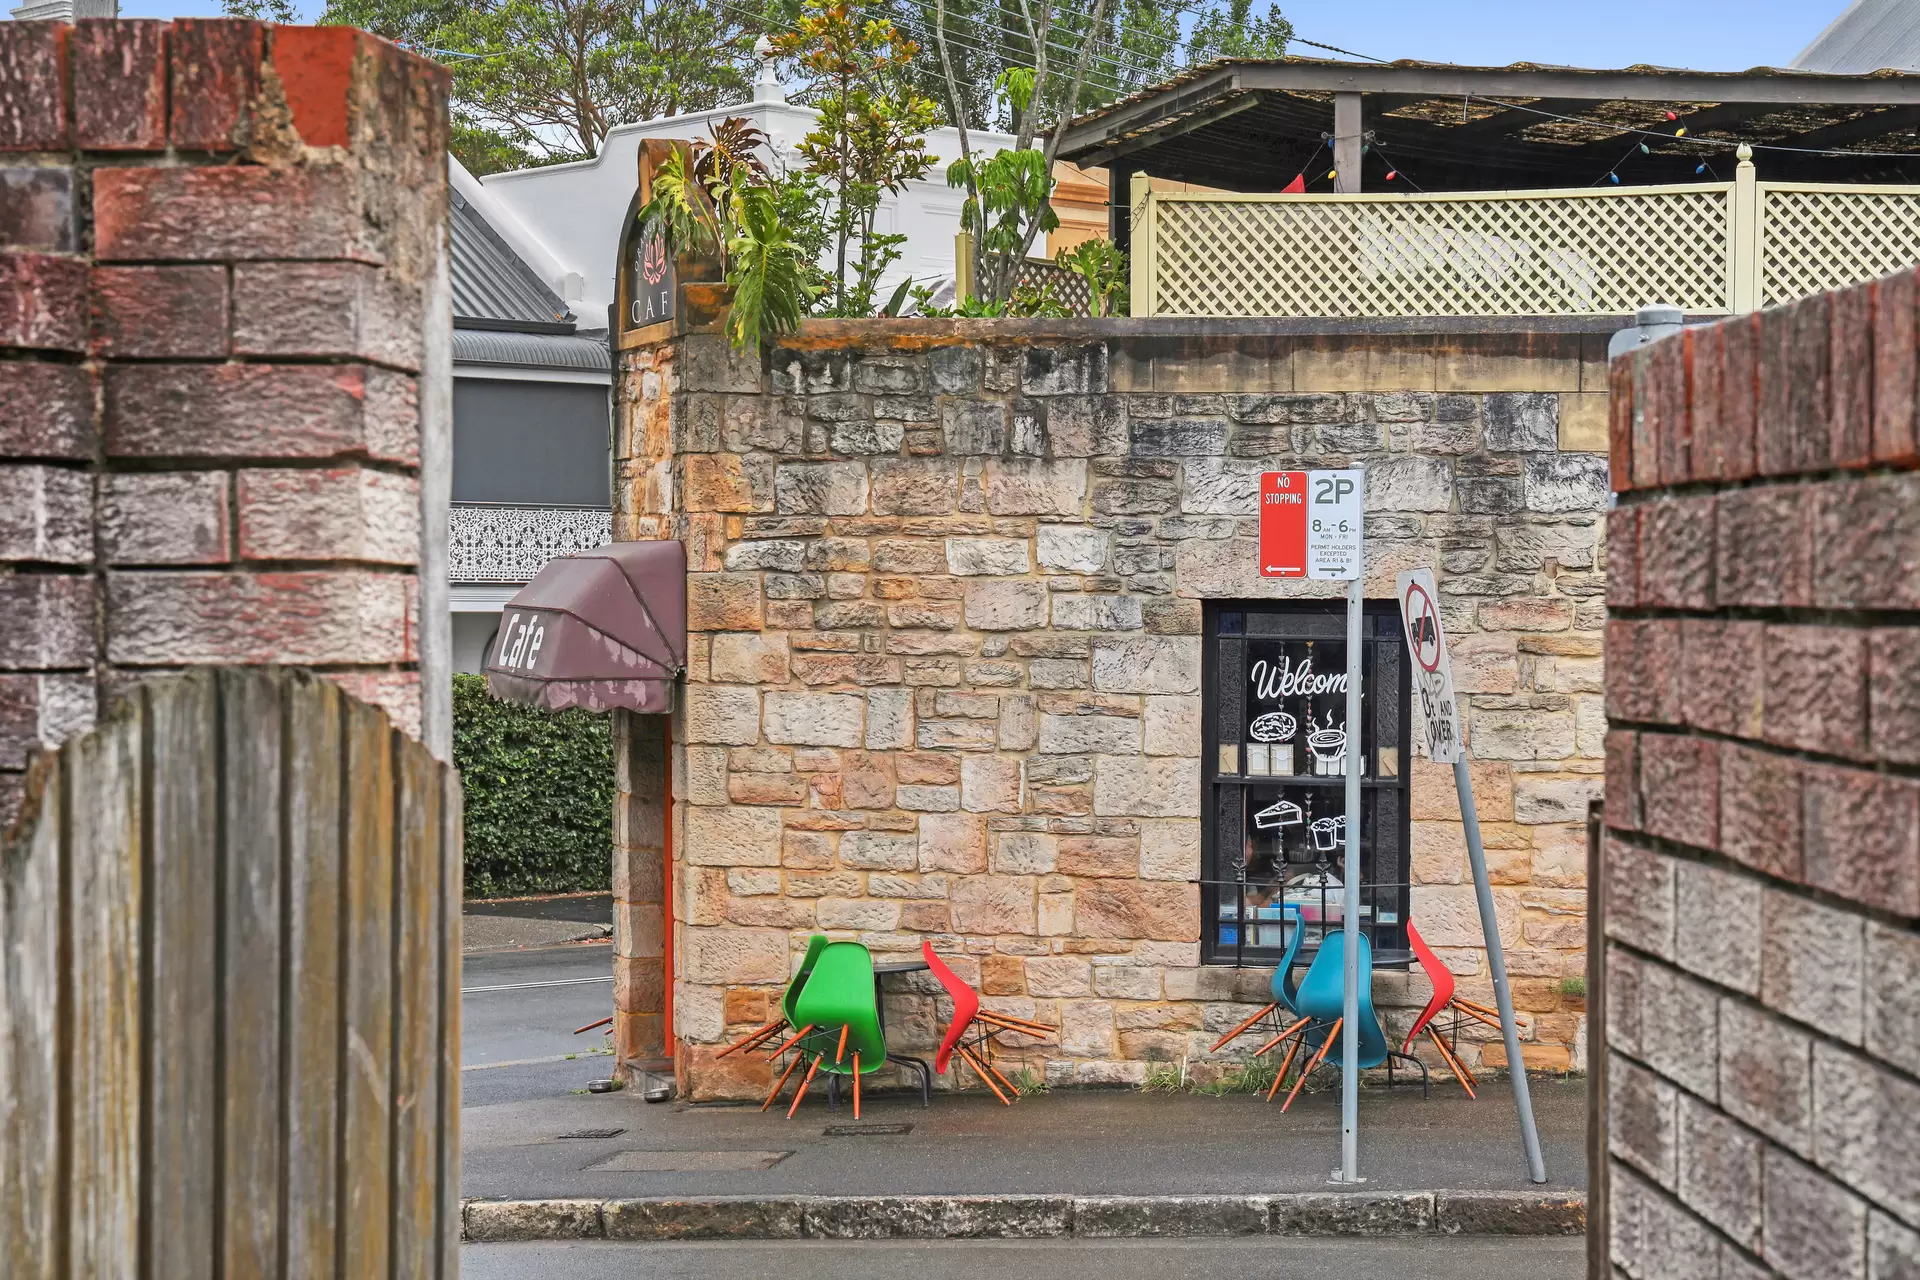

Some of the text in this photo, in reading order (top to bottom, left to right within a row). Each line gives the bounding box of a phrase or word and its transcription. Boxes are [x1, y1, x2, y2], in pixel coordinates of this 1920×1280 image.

[631, 290, 668, 324] CAF
[1277, 477, 1290, 488] NO
[1315, 478, 1354, 504] 2P
[1265, 493, 1302, 505] STOPPING
[498, 613, 545, 671] Cafe
[1251, 656, 1365, 700] Welcom
[1440, 700, 1453, 717] AND
[1430, 719, 1453, 741] OVER
